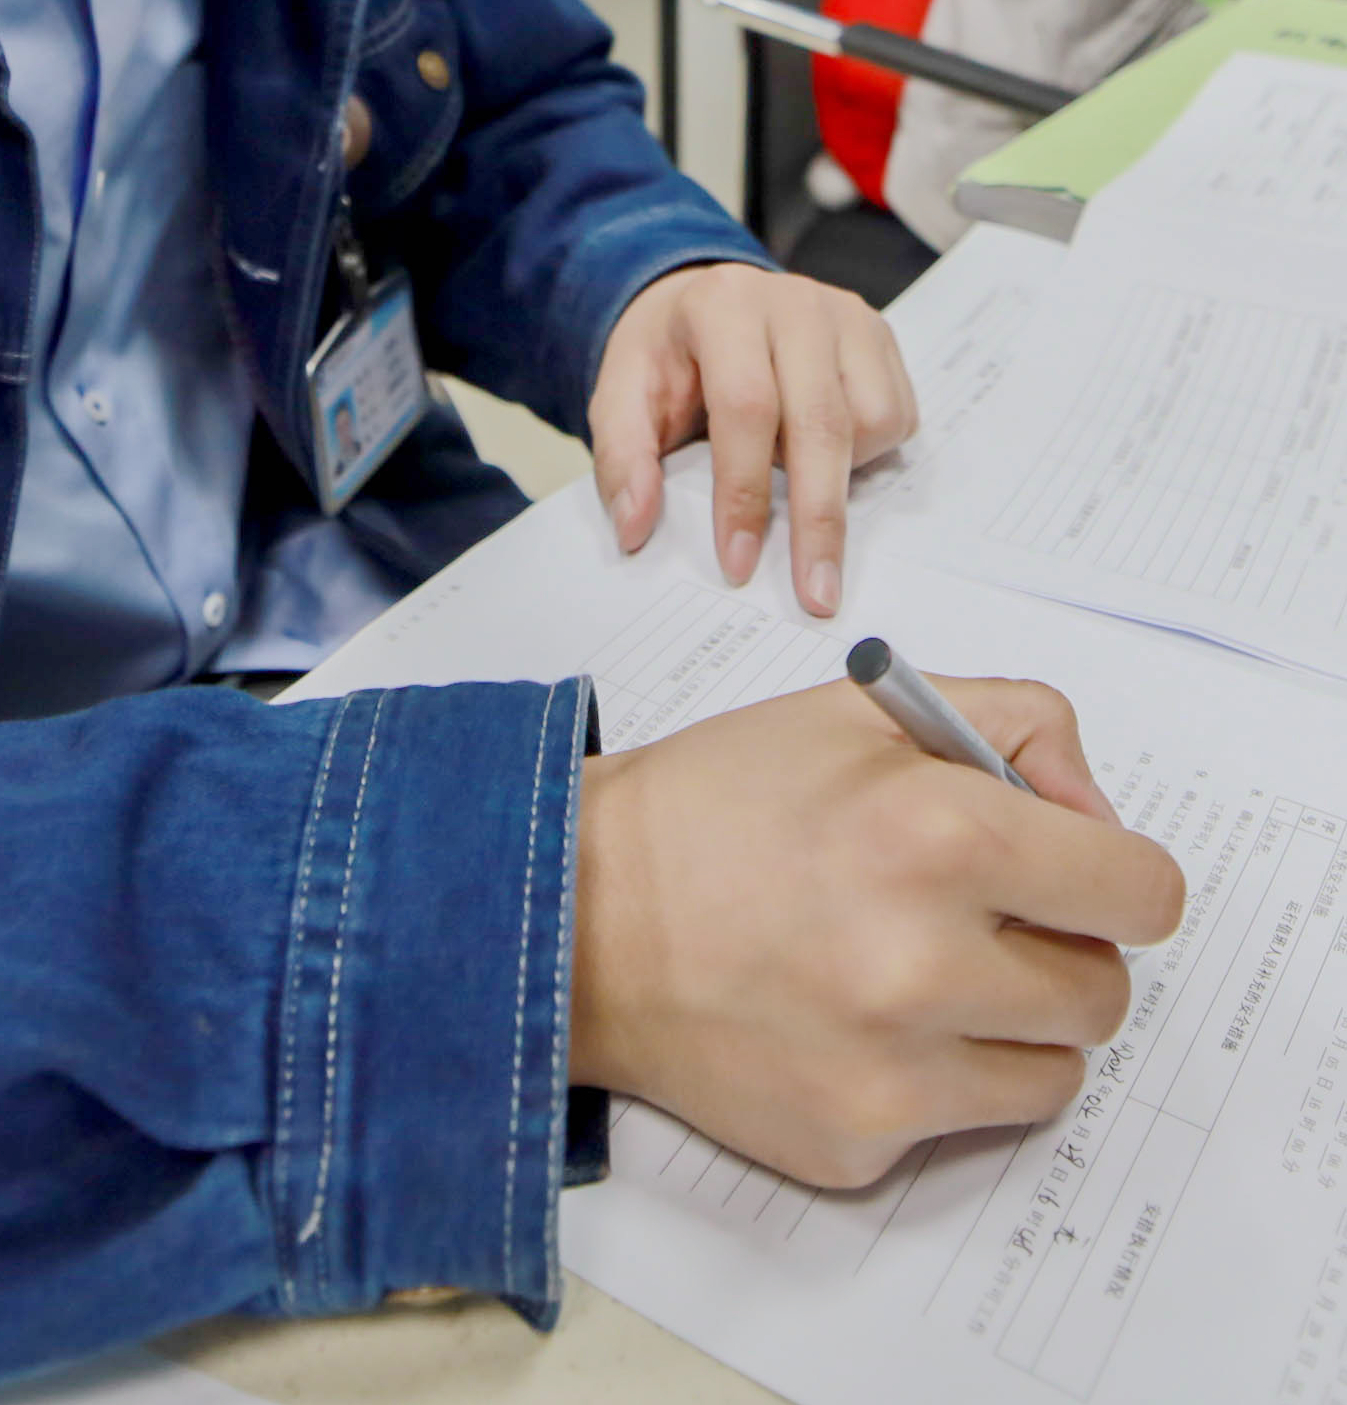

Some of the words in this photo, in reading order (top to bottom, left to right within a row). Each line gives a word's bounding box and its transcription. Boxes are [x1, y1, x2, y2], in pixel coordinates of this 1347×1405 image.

[1221, 901, 1299, 1052] 运行值班人员补充的安全措施
